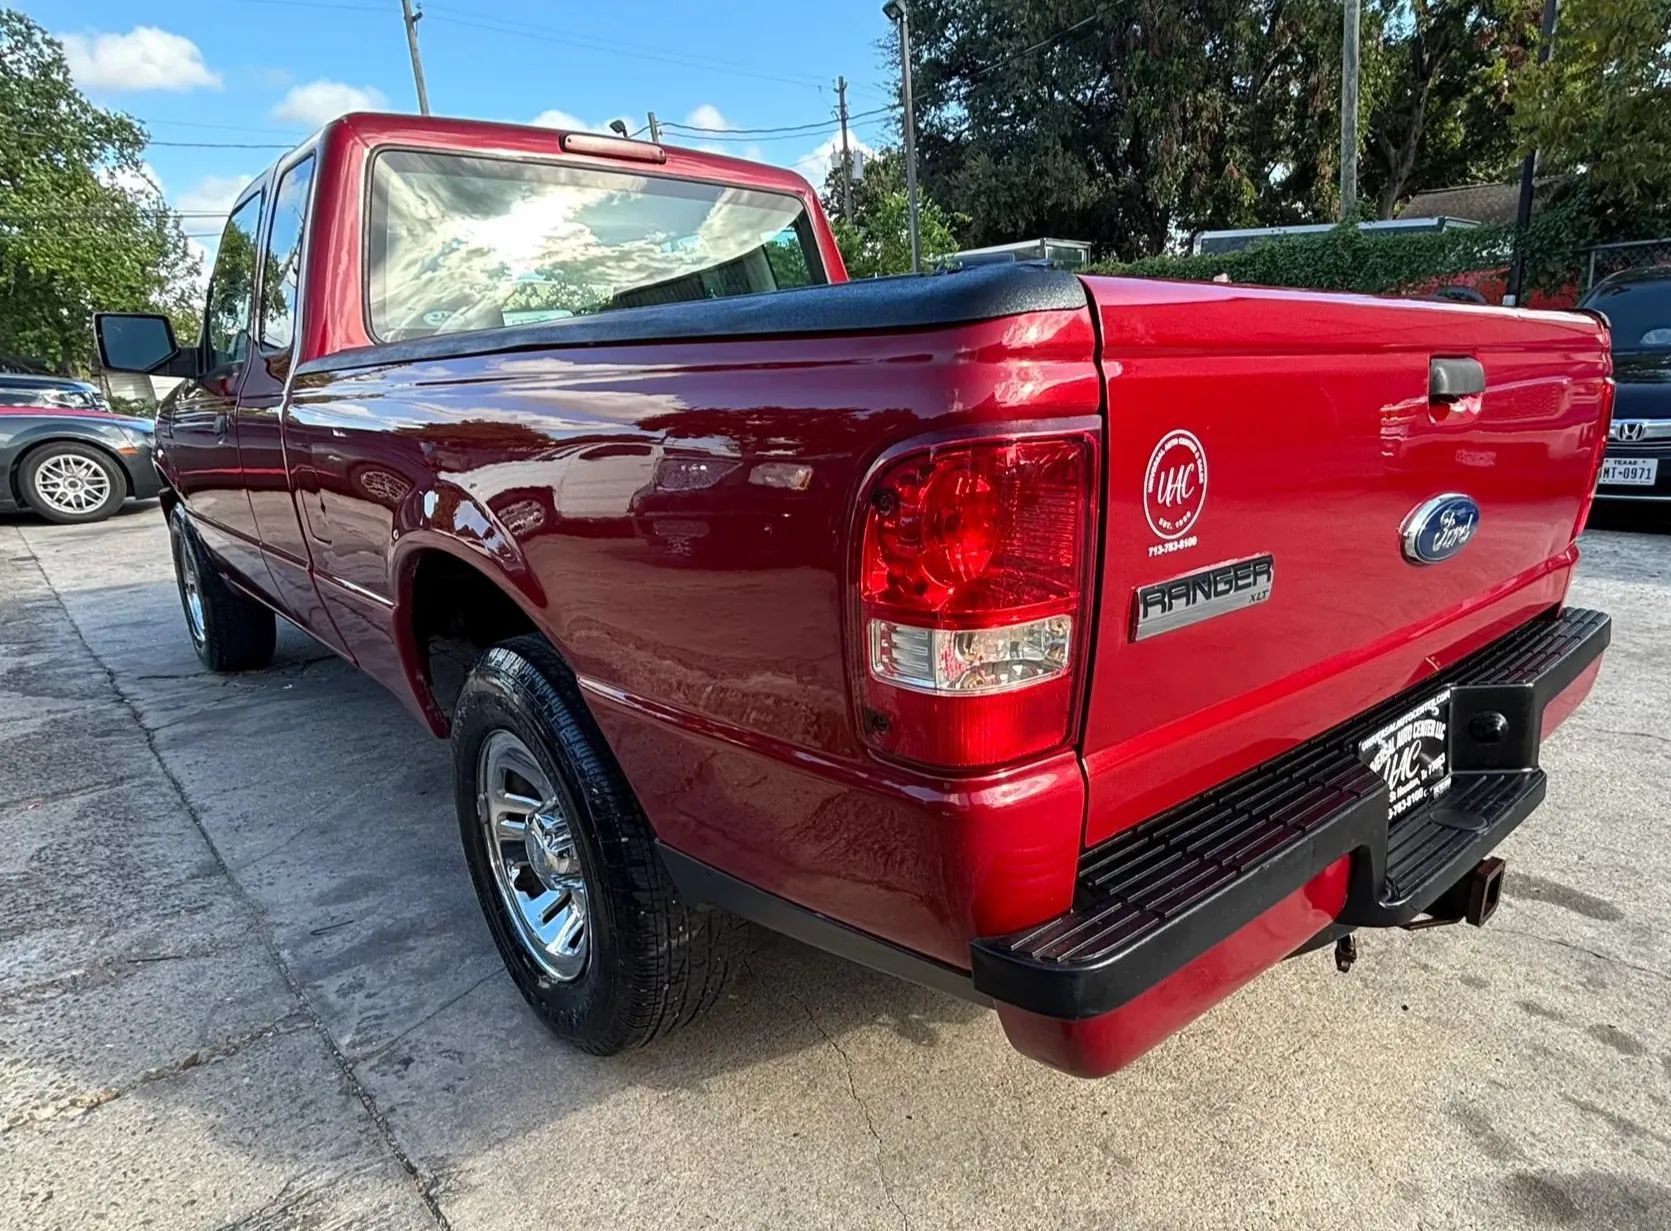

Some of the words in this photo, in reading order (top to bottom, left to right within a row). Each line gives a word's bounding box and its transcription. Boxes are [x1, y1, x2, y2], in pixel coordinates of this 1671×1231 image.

[1432, 508, 1474, 552] Ford
[1141, 556, 1273, 619] RANGER
[1248, 588, 1270, 604] XLT
